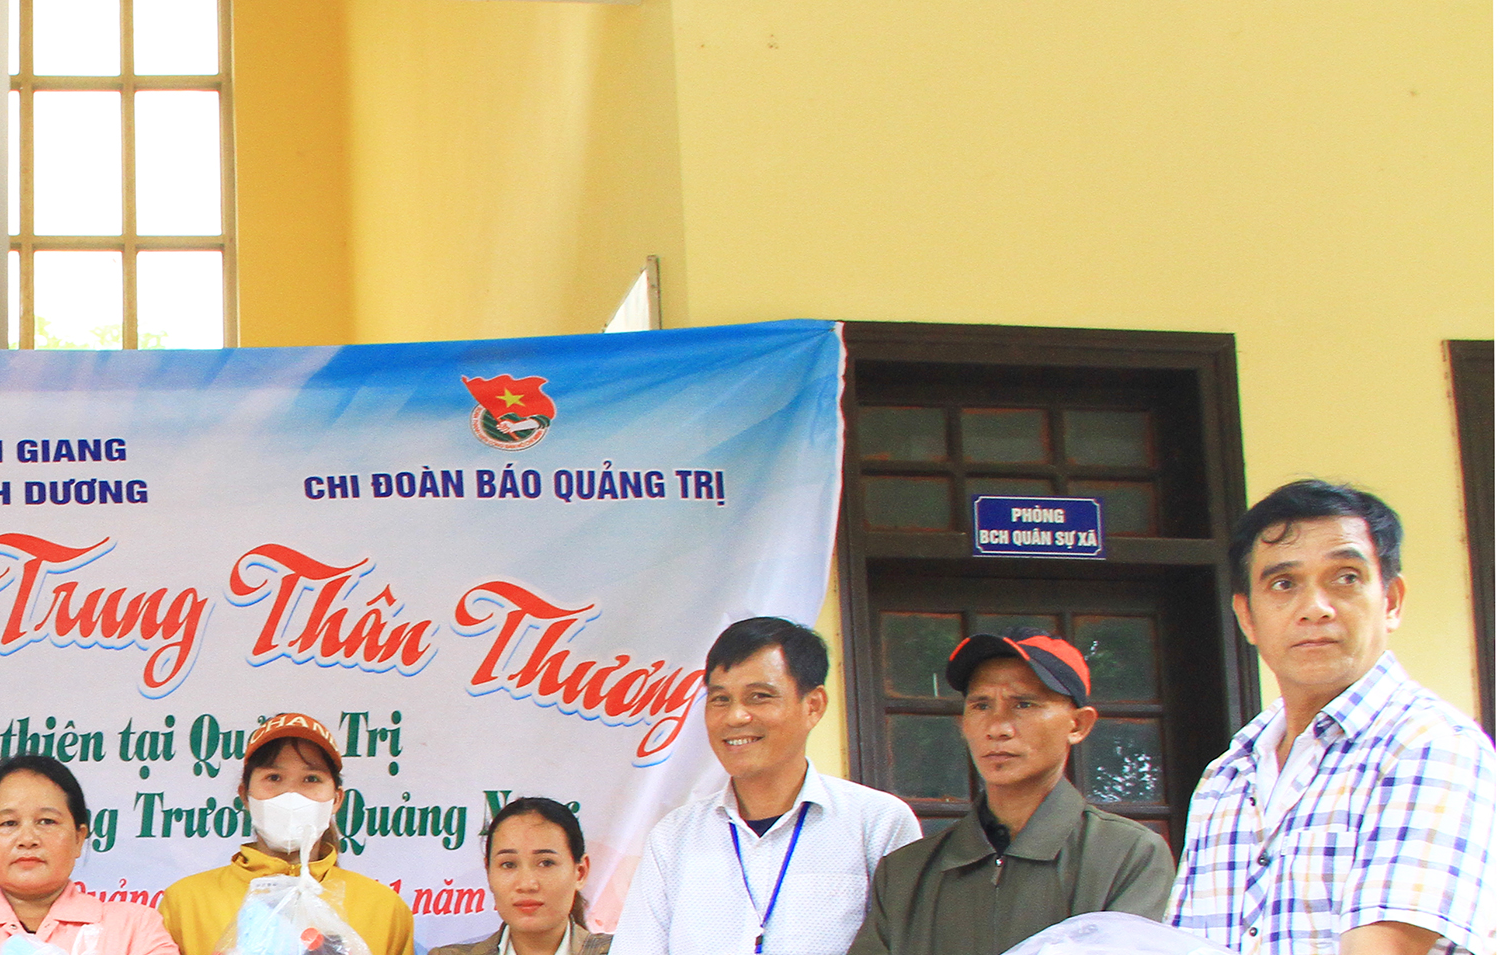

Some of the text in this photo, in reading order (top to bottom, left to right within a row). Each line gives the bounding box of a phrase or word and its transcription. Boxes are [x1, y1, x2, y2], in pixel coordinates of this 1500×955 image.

[16, 438, 127, 463] GIANG
[24, 476, 148, 505] DƯƠNG
[304, 459, 725, 506] CHI ĐOÀN BÁO QUẢNG TRỊ
[1011, 505, 1065, 523] PHÒNG
[979, 528, 1097, 549] BCH QUÂN SỰ XÃ
[229, 543, 431, 664] Thân
[454, 580, 709, 758] Thương
[119, 714, 176, 779] tại
[338, 709, 404, 776] Trị
[336, 788, 467, 856] Quảng
[412, 878, 486, 916] năm
